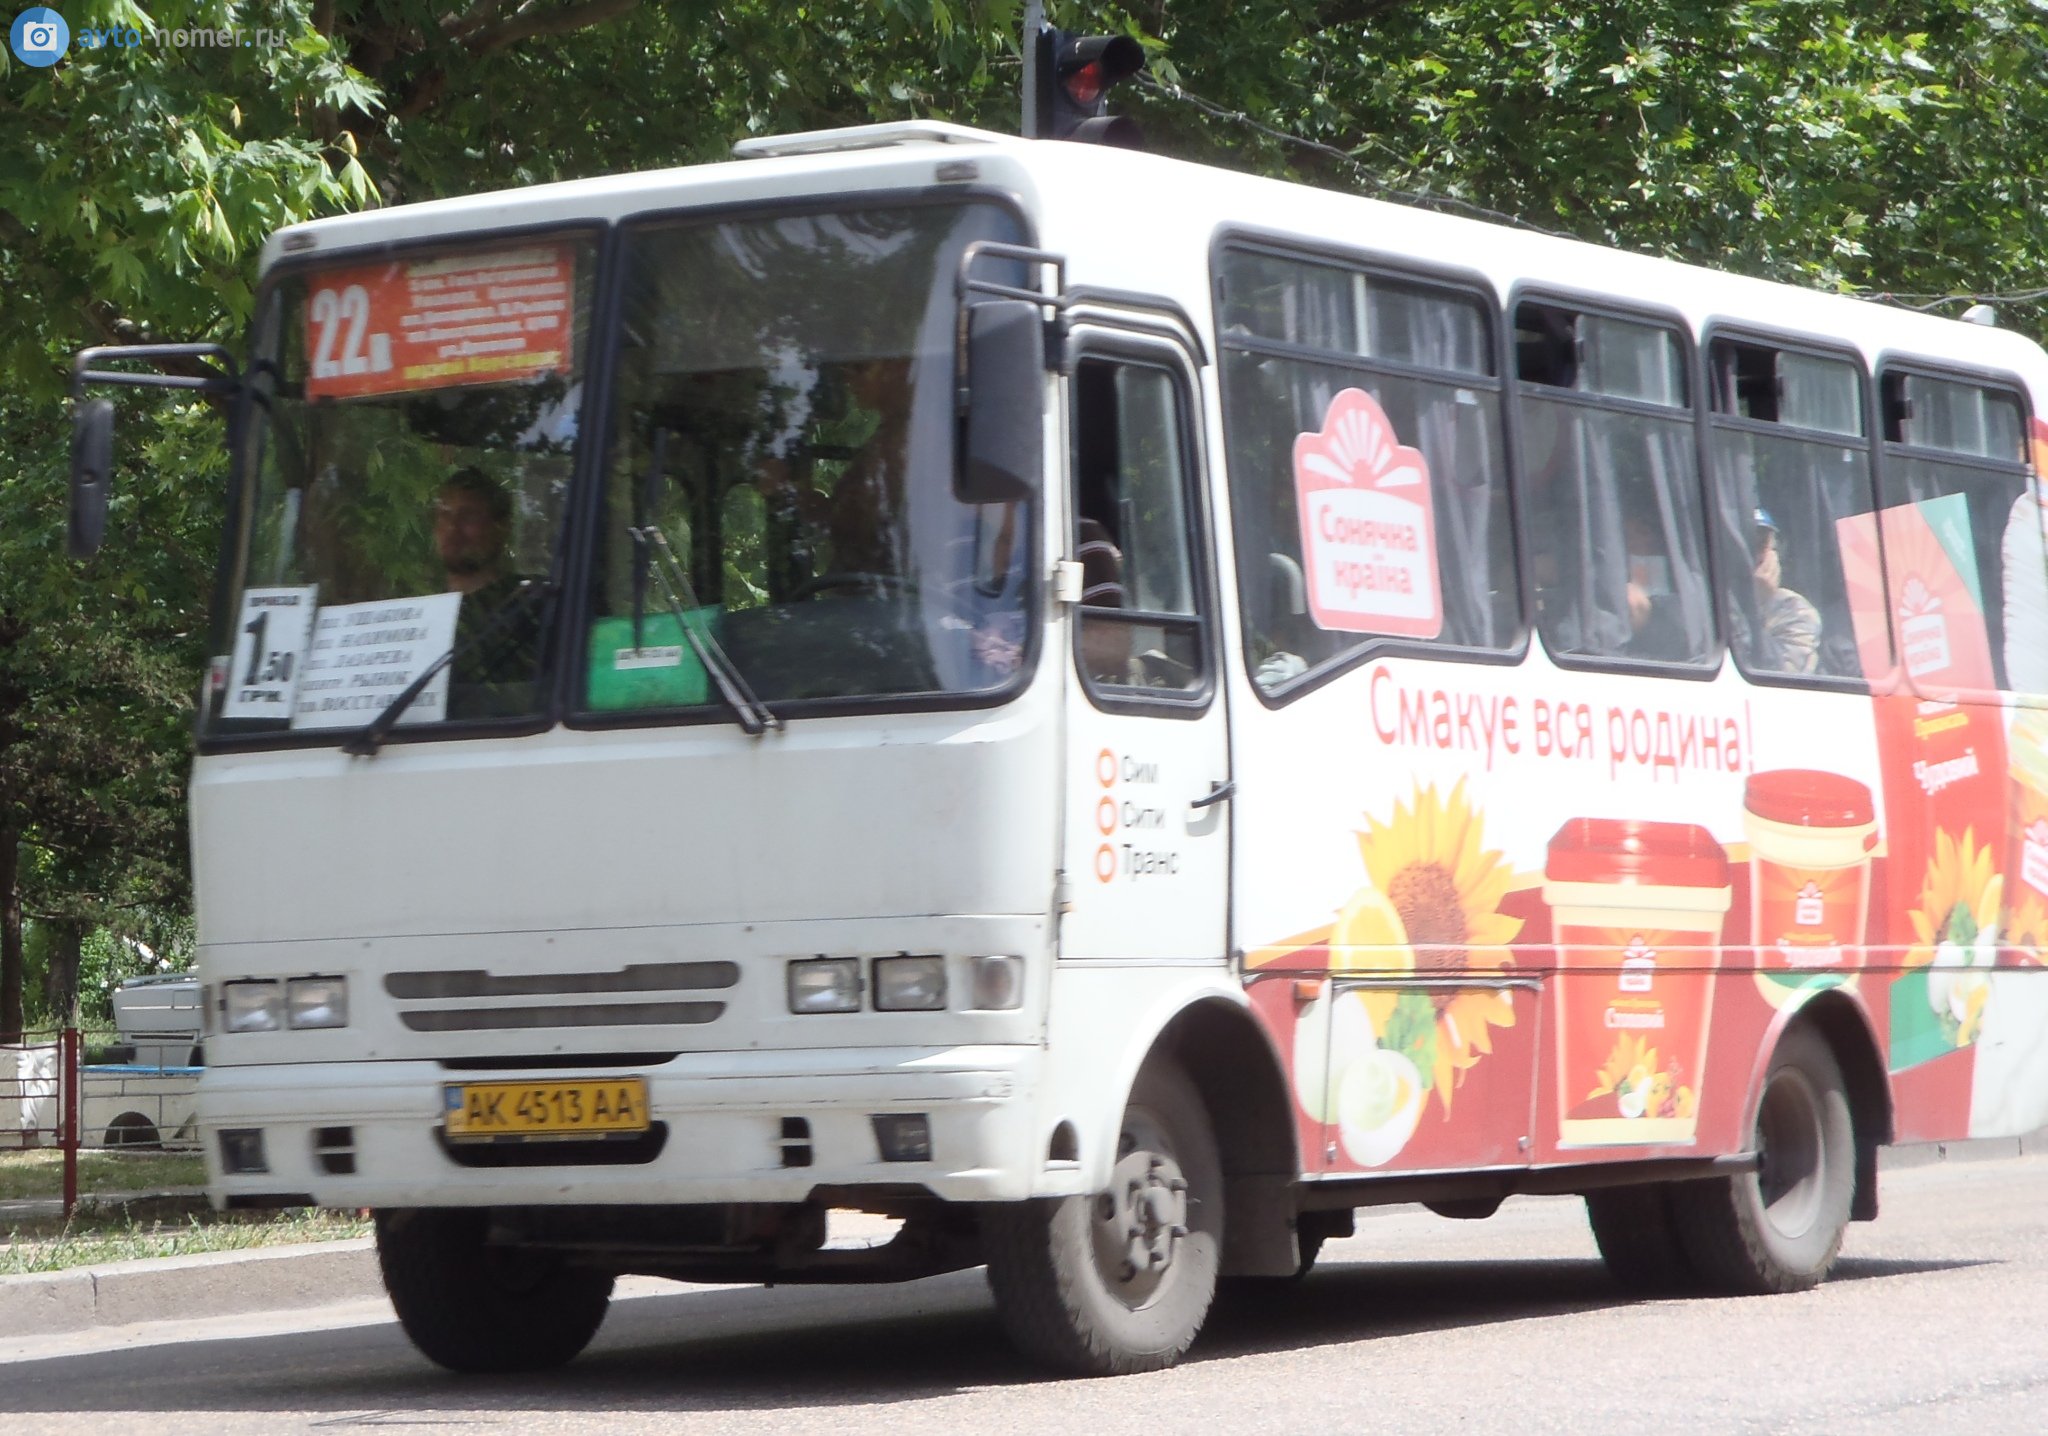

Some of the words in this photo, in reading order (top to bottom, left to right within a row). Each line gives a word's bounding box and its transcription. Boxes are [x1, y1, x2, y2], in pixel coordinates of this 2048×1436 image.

[1318, 503, 1418, 553] Сонячна
[1369, 665, 1521, 772] Смакує
[1534, 698, 1594, 760] вся
[1607, 698, 1756, 784] родина!
[1120, 843, 1180, 882] Транс
[514, 1089, 583, 1124] 4513
